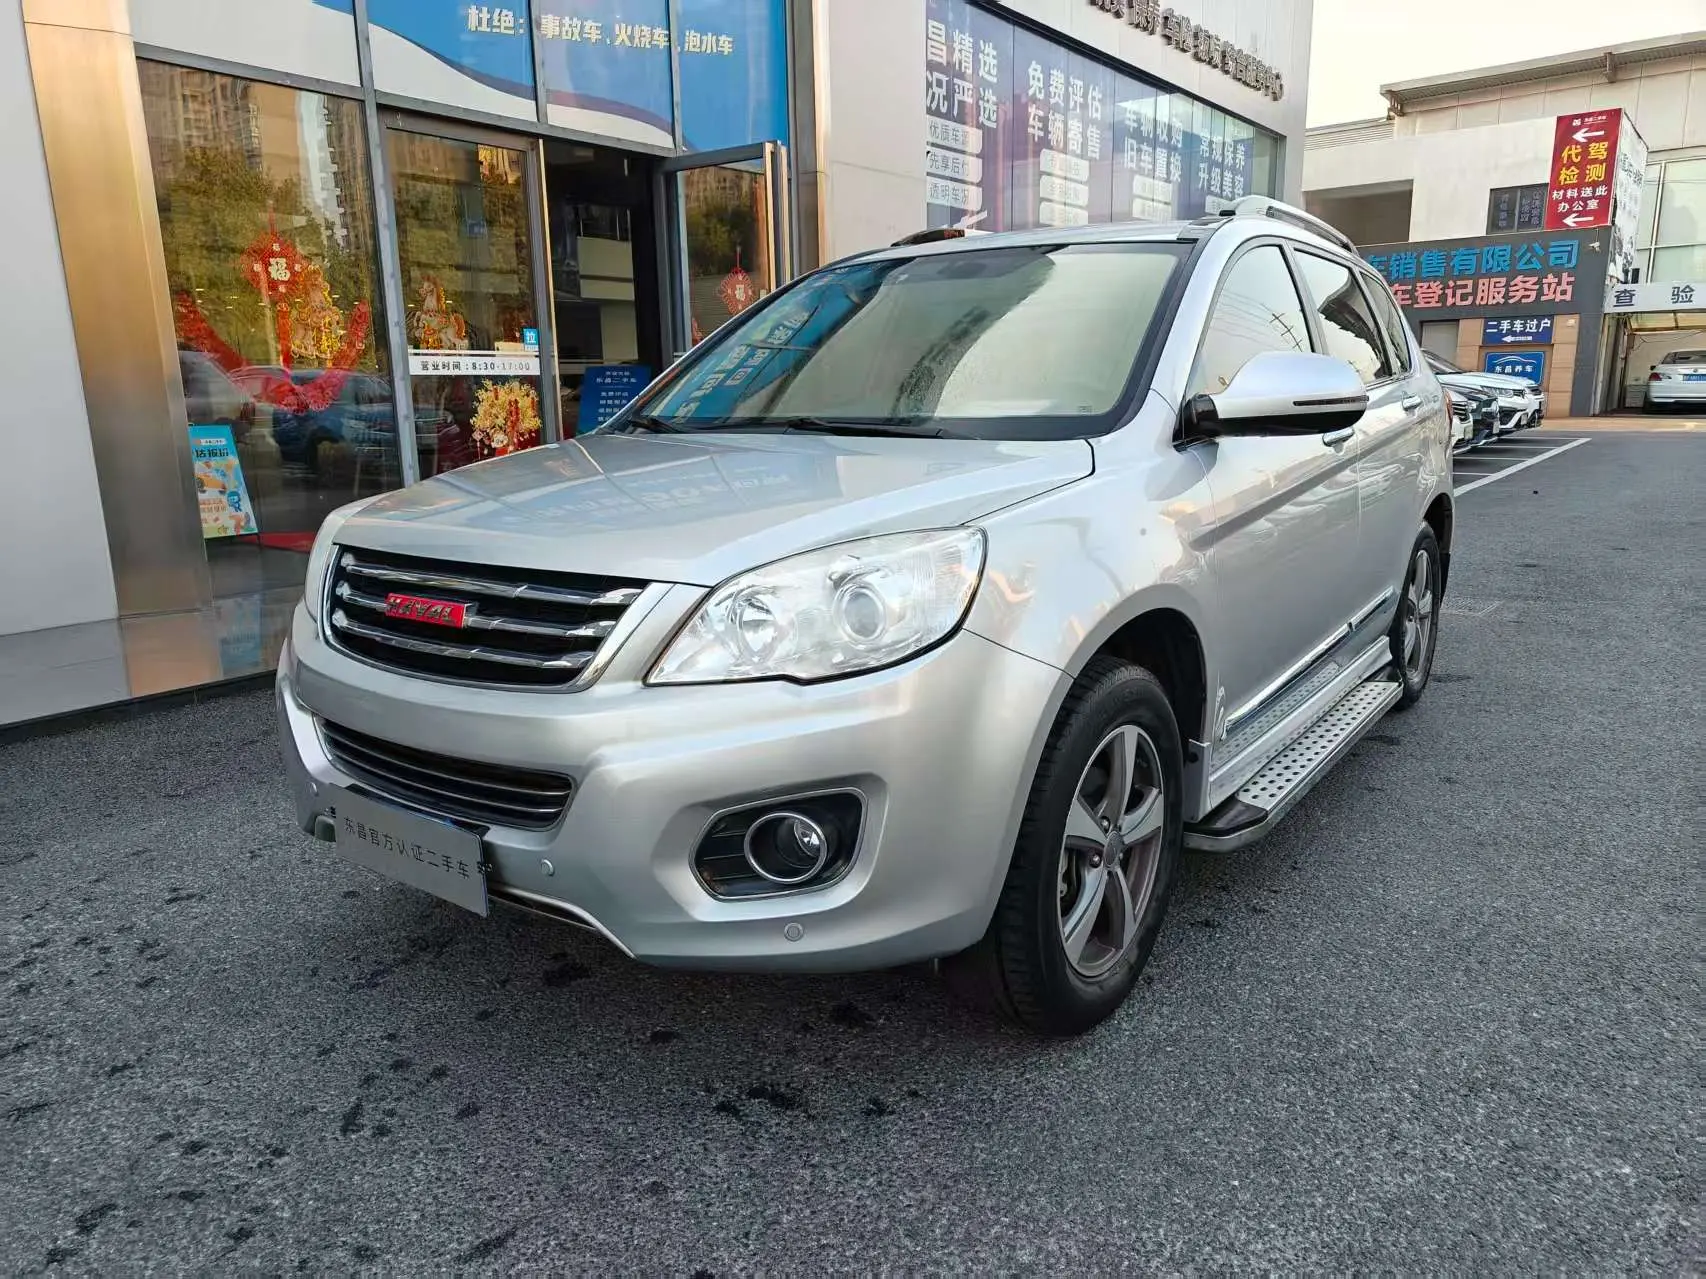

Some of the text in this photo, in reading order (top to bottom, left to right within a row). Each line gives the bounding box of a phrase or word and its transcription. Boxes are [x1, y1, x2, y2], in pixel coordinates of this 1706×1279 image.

[927, 19, 997, 83] 昌精选
[926, 71, 997, 128] 况严选
[1028, 60, 1102, 121] 免费评估
[1027, 103, 1102, 160] 车辆寄售
[1561, 142, 1609, 163] 代驾
[1552, 185, 1608, 200] 材料送此
[1558, 164, 1606, 186] 检测
[1557, 199, 1600, 213] 办公室
[1390, 271, 1576, 308] 车登记服务站
[1485, 318, 1552, 334] 二手车过户
[343, 816, 470, 880] 东昌官方认证二手车
